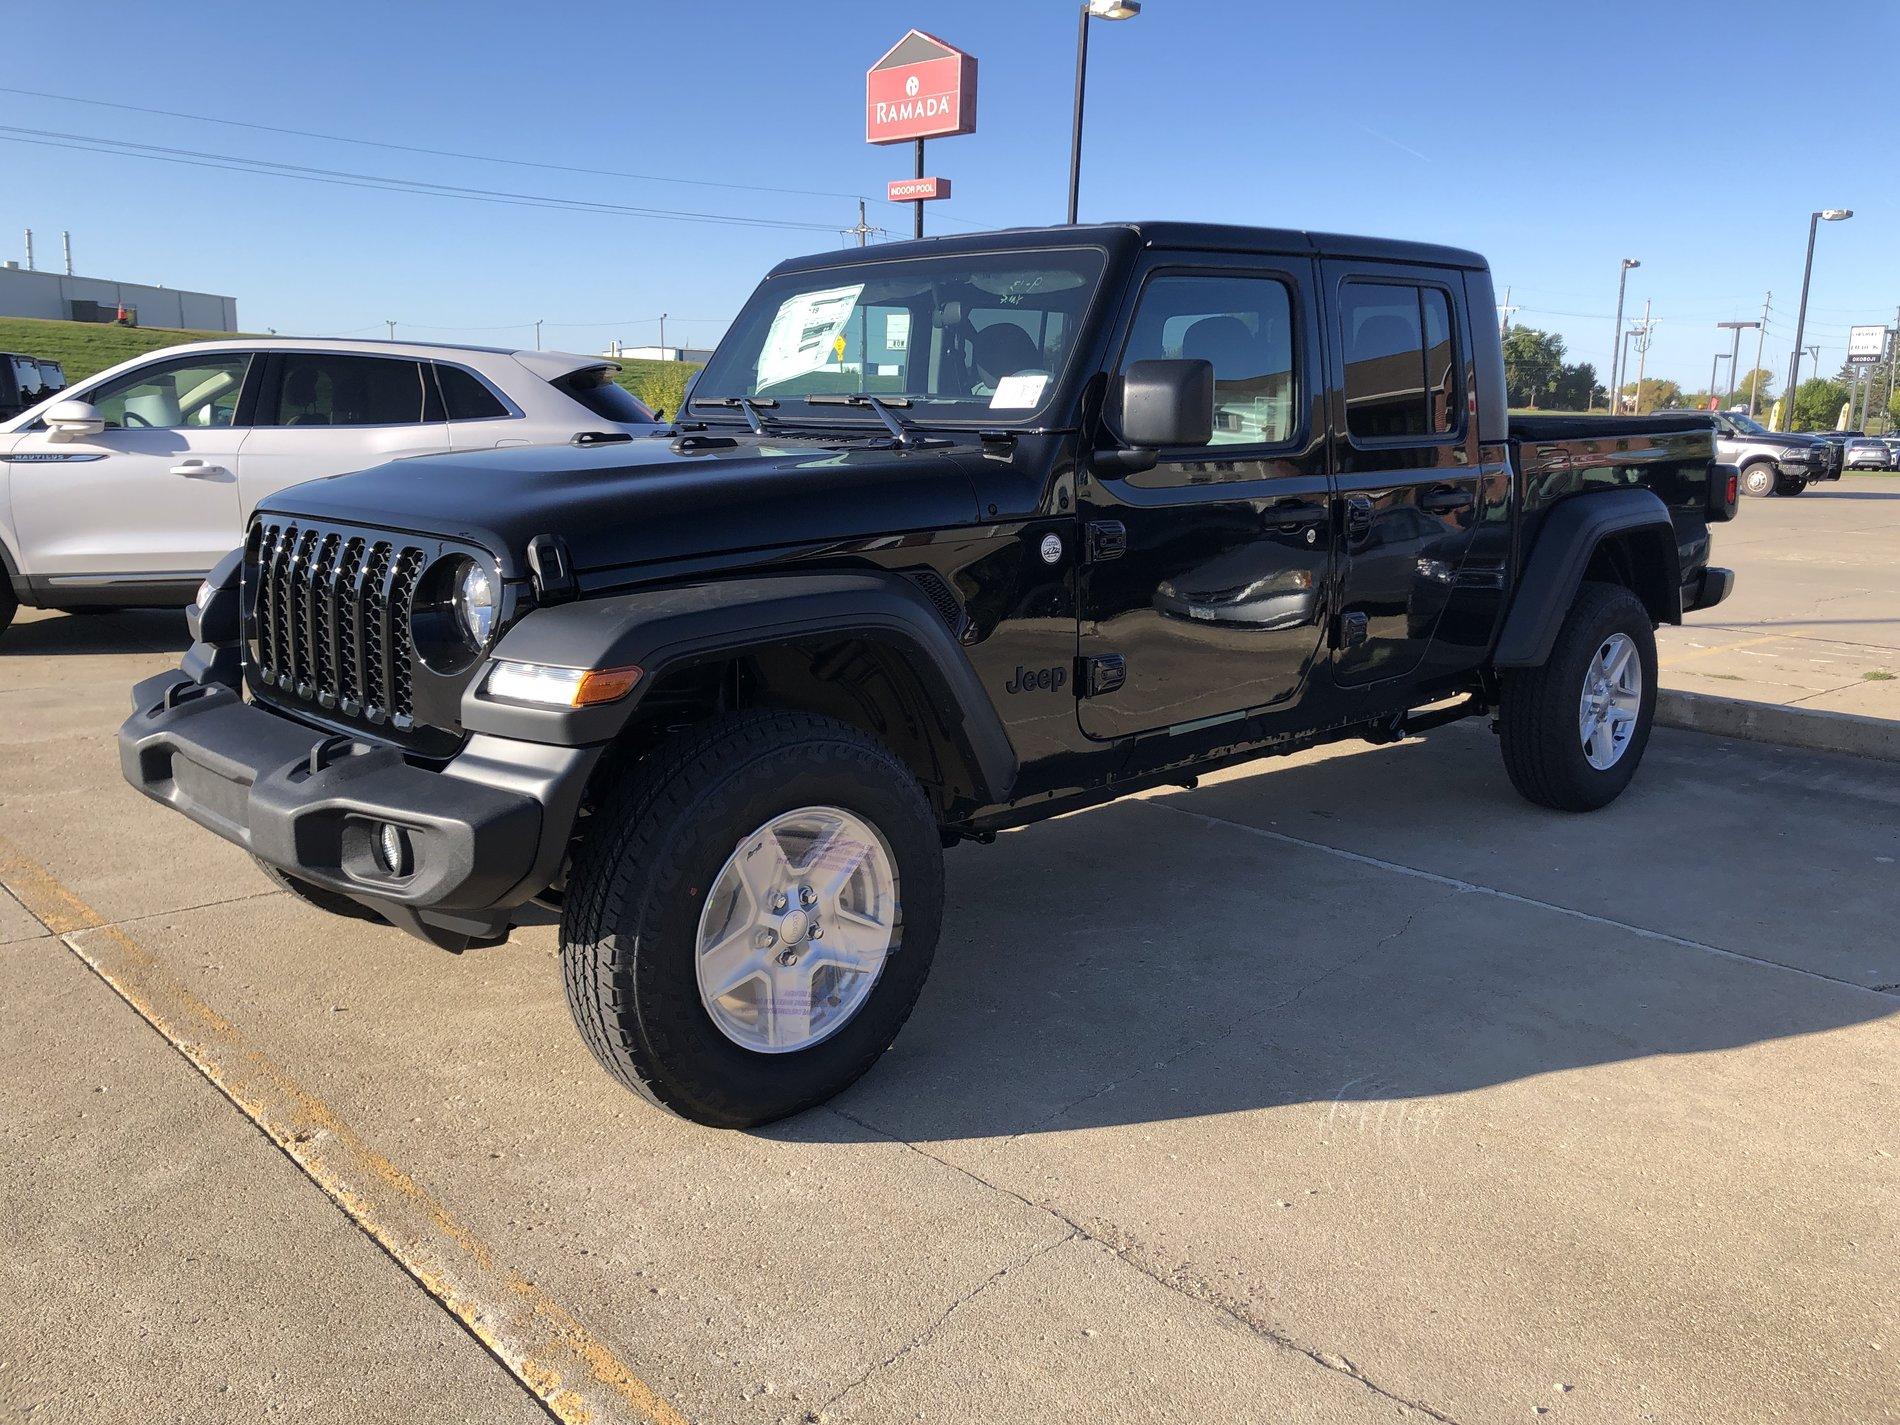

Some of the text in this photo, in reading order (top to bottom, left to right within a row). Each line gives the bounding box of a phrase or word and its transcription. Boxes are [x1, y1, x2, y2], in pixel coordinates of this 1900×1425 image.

[876, 96, 949, 124] RAMADA
[890, 183, 934, 196] INDOOR POOL
[15, 453, 65, 461] NAUTILUS
[1005, 665, 1068, 695] Jeep
